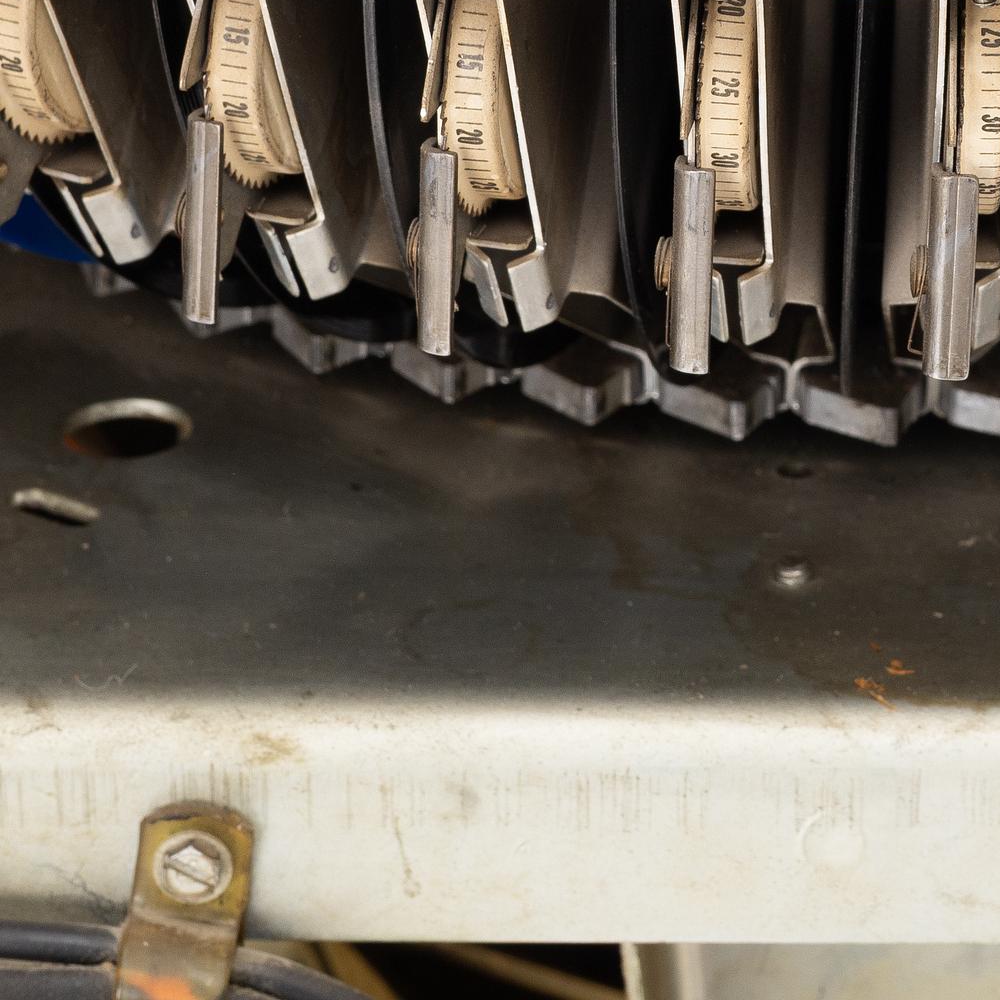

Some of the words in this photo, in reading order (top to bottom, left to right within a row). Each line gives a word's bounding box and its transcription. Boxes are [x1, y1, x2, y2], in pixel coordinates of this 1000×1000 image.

[223, 26, 250, 46] 15
[2, 56, 23, 73] 20
[456, 53, 484, 72] 15
[711, 77, 740, 98] 25
[223, 101, 250, 118] 20
[456, 129, 484, 145] 20
[711, 152, 739, 168] 30
